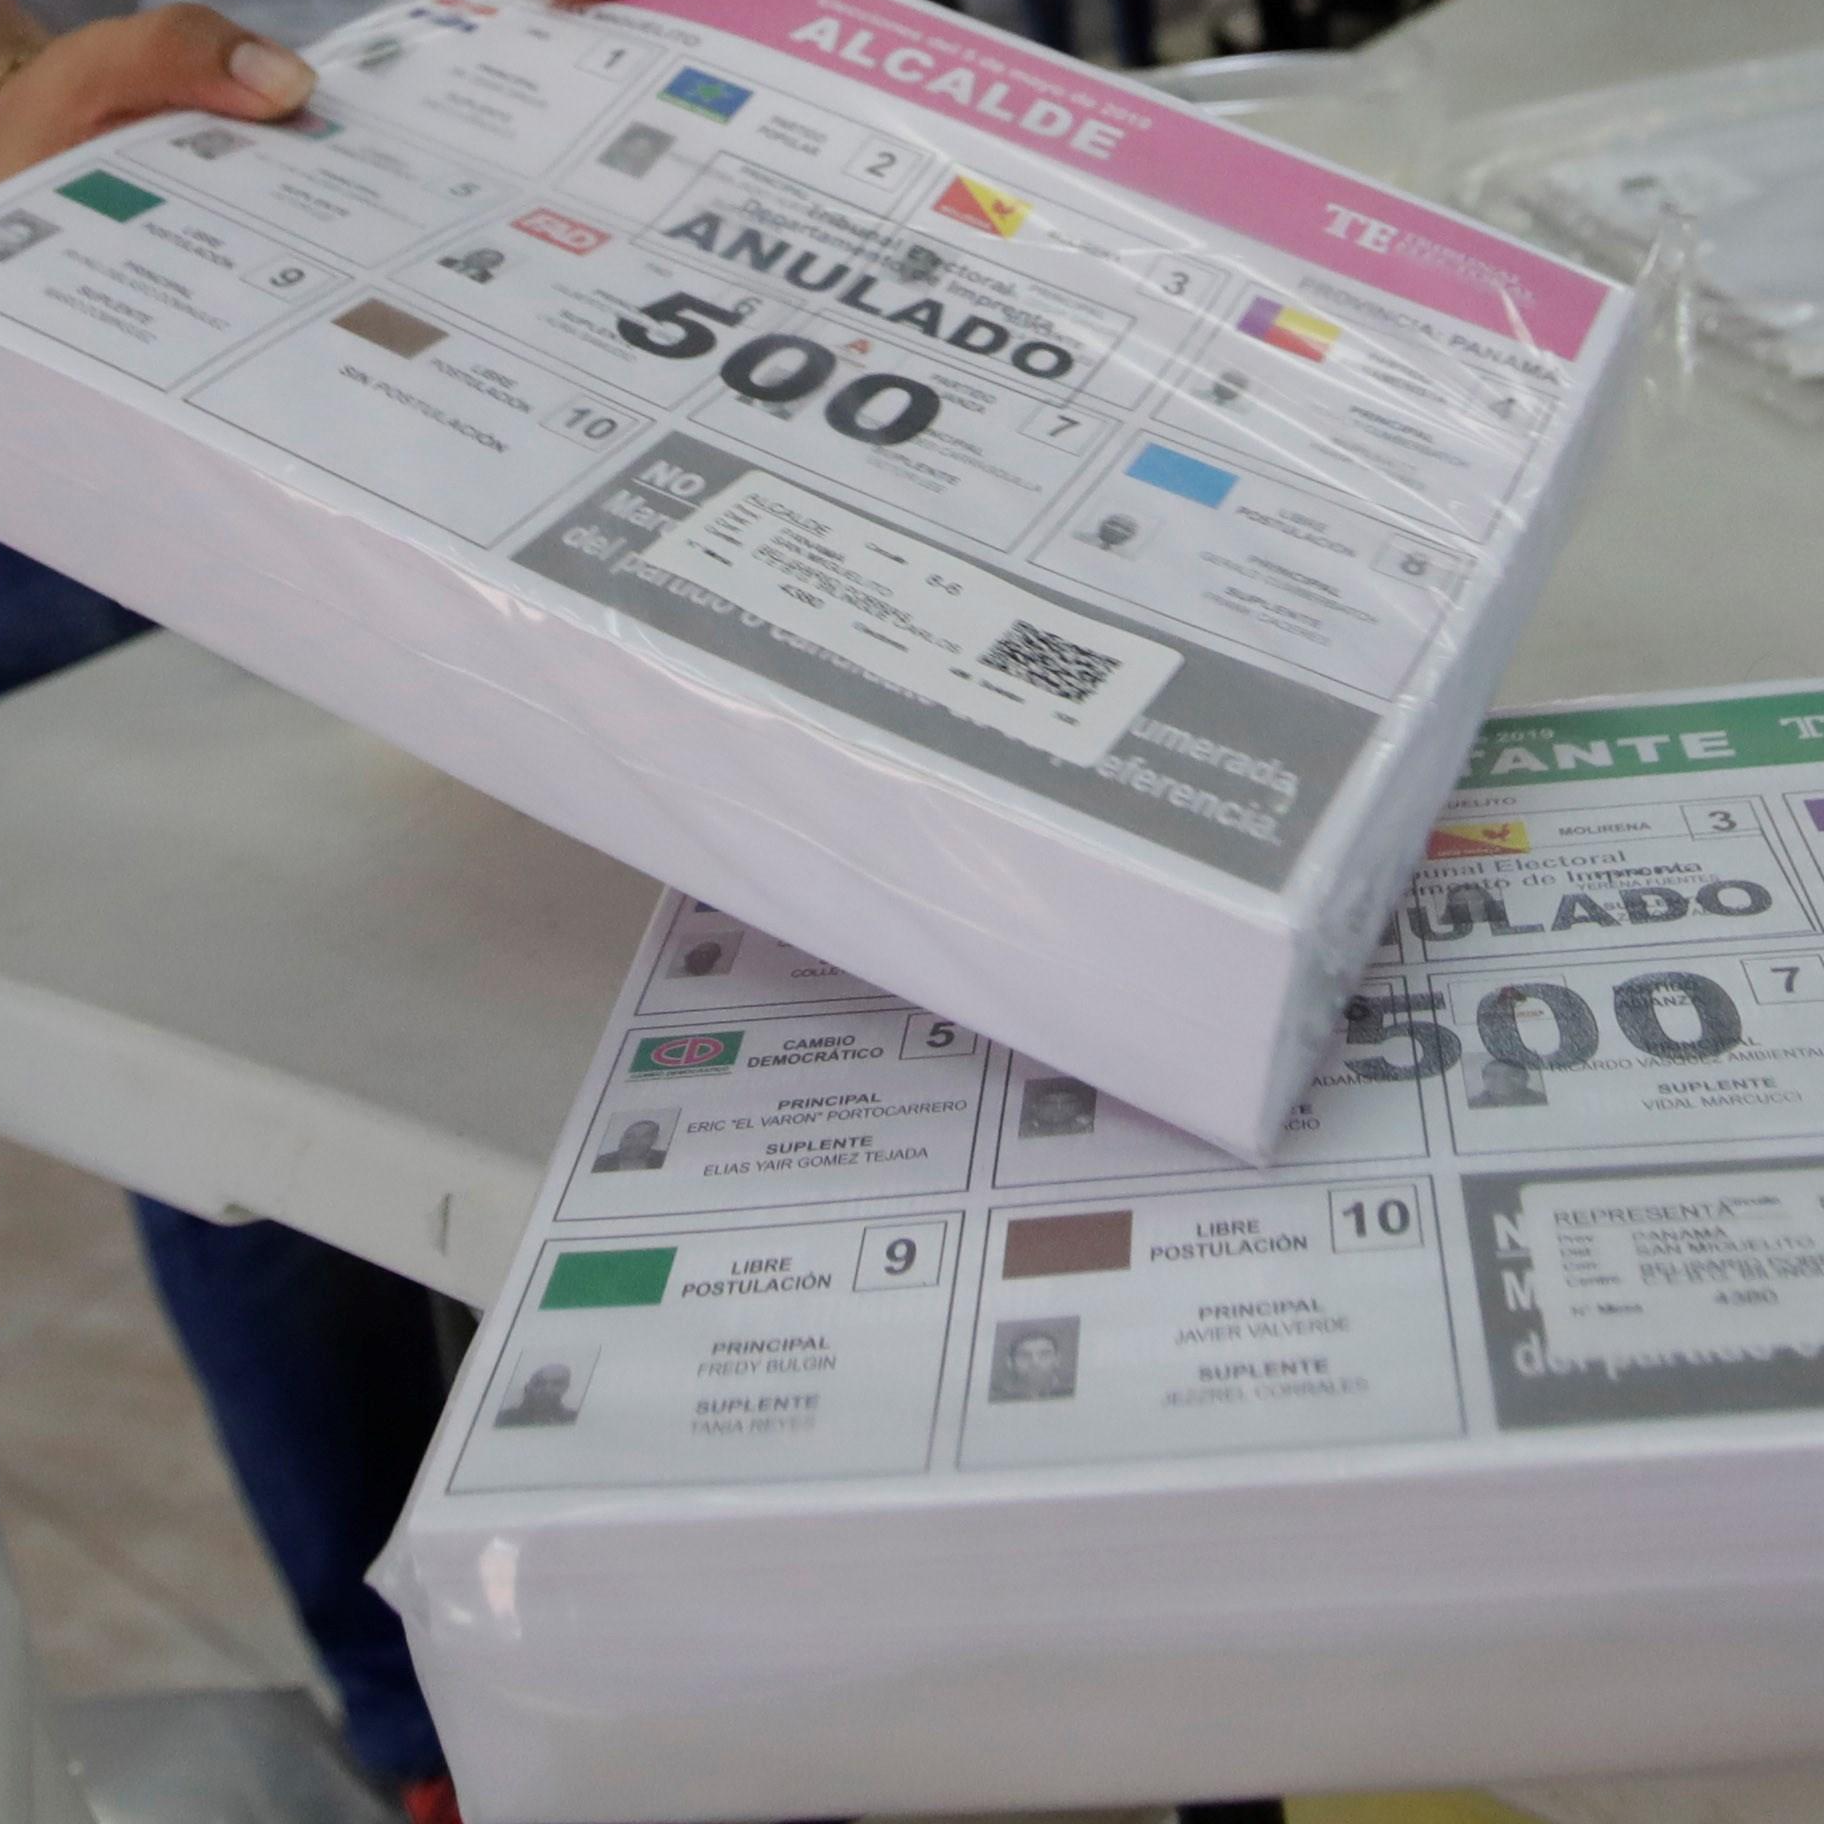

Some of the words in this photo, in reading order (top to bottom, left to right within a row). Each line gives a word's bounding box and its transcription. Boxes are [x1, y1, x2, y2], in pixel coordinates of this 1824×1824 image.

[604, 47, 626, 70] 1
[789, 16, 1125, 161] ALCALDE
[865, 152, 897, 176] 2
[1324, 203, 1399, 254] TE
[261, 265, 313, 292] 9
[1156, 269, 1199, 298] 3
[662, 210, 1075, 379] ANULADO
[615, 291, 941, 447] 500
[332, 363, 376, 386] SIN
[365, 378, 515, 455] POSTULACIÓN
[550, 402, 625, 444] 10
[1041, 413, 1085, 443] 7
[636, 458, 713, 501] NO
[739, 491, 836, 537] ALCALDE
[1393, 548, 1435, 581] 8
[1128, 716, 1300, 796] umerada
[1704, 809, 1741, 832] 3
[1493, 850, 1628, 872] Electoral
[1519, 872, 1558, 886] de
[1391, 877, 1780, 944] ULADO
[1769, 966, 1809, 994] 7
[924, 1020, 960, 1048] 5
[1338, 966, 1756, 1085] 500
[744, 1044, 887, 1069] DEMOCRÁTICO
[780, 1034, 857, 1051] CAMBIO
[775, 1091, 884, 1110] PRINCIPAL
[1654, 1076, 1779, 1096] SUPLENTE
[684, 1120, 728, 1134] ERIC
[824, 1098, 970, 1122] PORTOCARRERO
[762, 1135, 875, 1155] SUPLENTE
[700, 1161, 753, 1177] ELIAS
[751, 1157, 796, 1173] YAIR
[795, 1152, 861, 1169] GOMEZ
[860, 1146, 931, 1164] TEJADA
[1193, 1219, 1261, 1239] LIBRE
[1338, 1196, 1414, 1240] 10
[879, 1237, 921, 1276] 9
[1147, 1232, 1310, 1263] POSTULACIÓN
[727, 1256, 795, 1276] LIBRE
[678, 1270, 836, 1299] POSTULACIÓN
[1196, 1297, 1326, 1321] PRINCIPAL
[707, 1334, 834, 1357] PRINCIPAL
[1196, 1357, 1331, 1381] SUPLENTE
[691, 1393, 822, 1415] SUPLENTE
